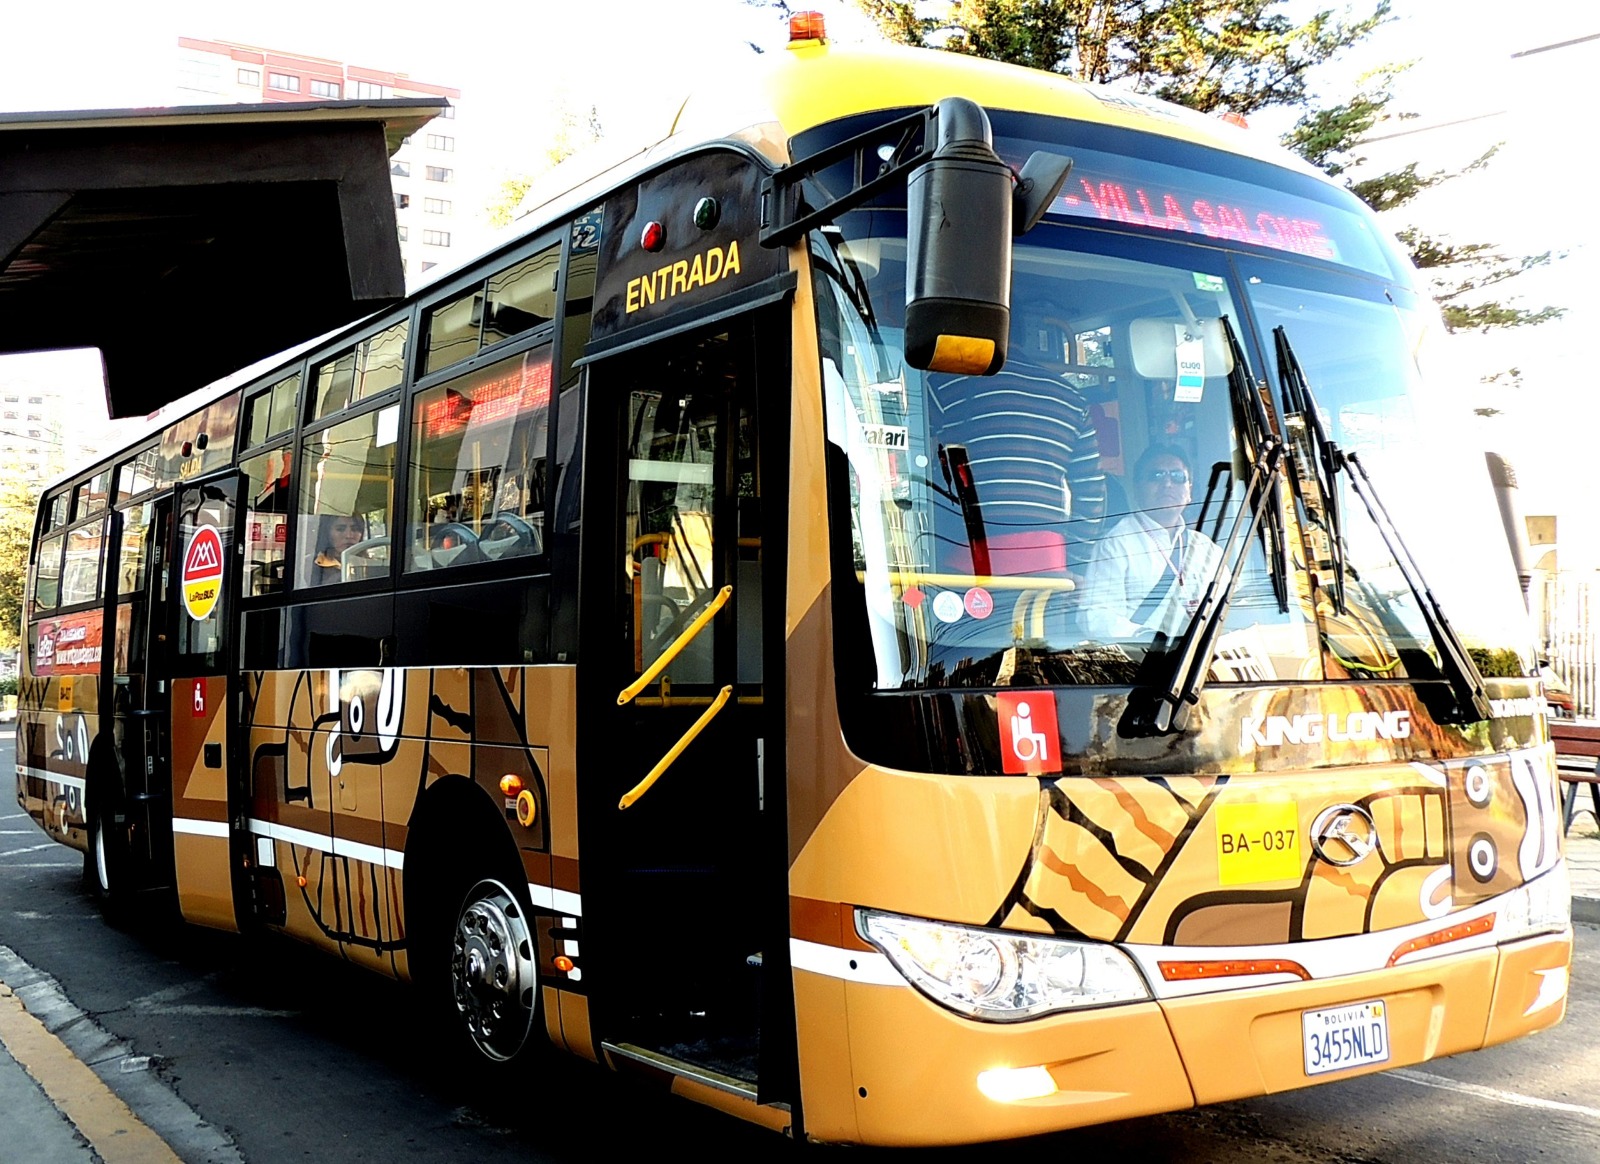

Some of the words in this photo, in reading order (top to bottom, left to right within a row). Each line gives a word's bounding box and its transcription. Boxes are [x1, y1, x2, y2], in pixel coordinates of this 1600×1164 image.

[1080, 178, 1193, 233] VILLA
[1192, 200, 1334, 257] SALOME
[625, 240, 741, 314] ENTRADA
[1239, 714, 1324, 752] KING
[1328, 710, 1410, 743] LONG
[1221, 829, 1296, 855] BA-037
[1324, 1010, 1365, 1025] BOLIVIA
[1310, 1022, 1383, 1067] 3455NLD
